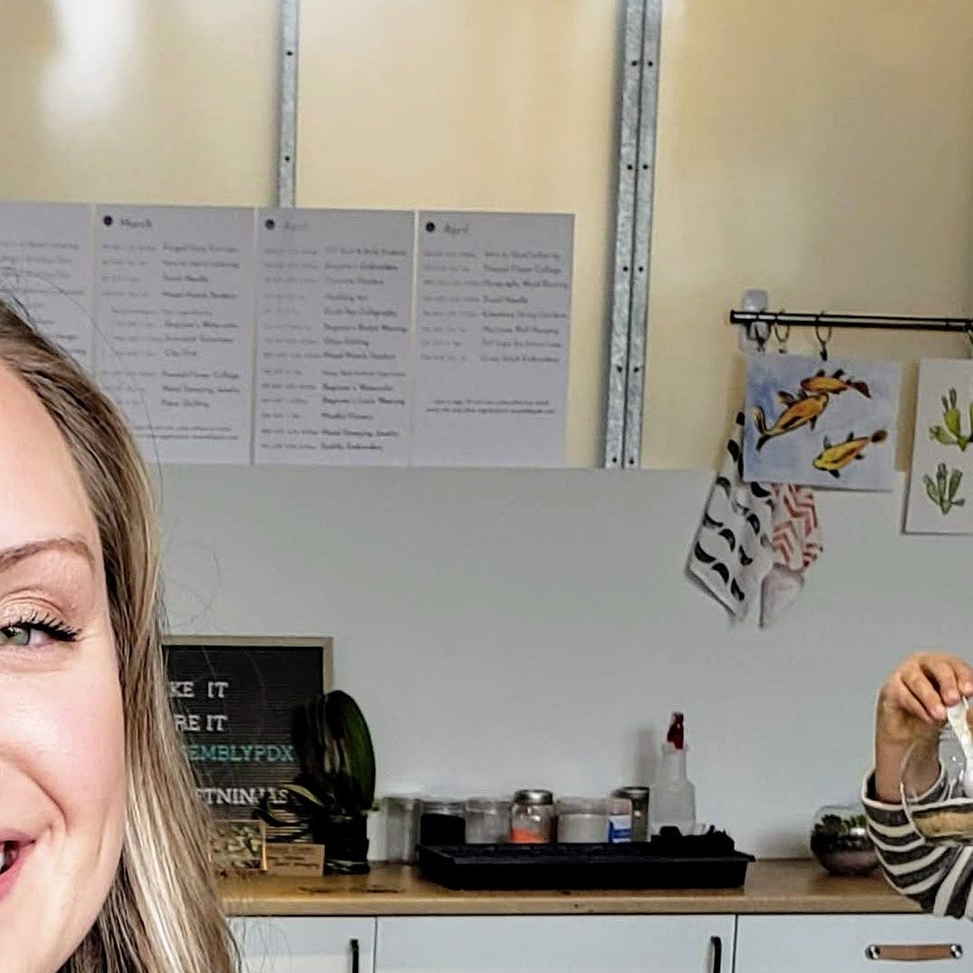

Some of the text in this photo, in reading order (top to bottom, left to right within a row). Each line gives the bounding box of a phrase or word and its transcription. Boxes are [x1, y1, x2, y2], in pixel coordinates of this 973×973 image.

[169, 681, 229, 698] KE IT
[173, 714, 228, 732] RE IT
[184, 744, 295, 762] EMBLYPDX
